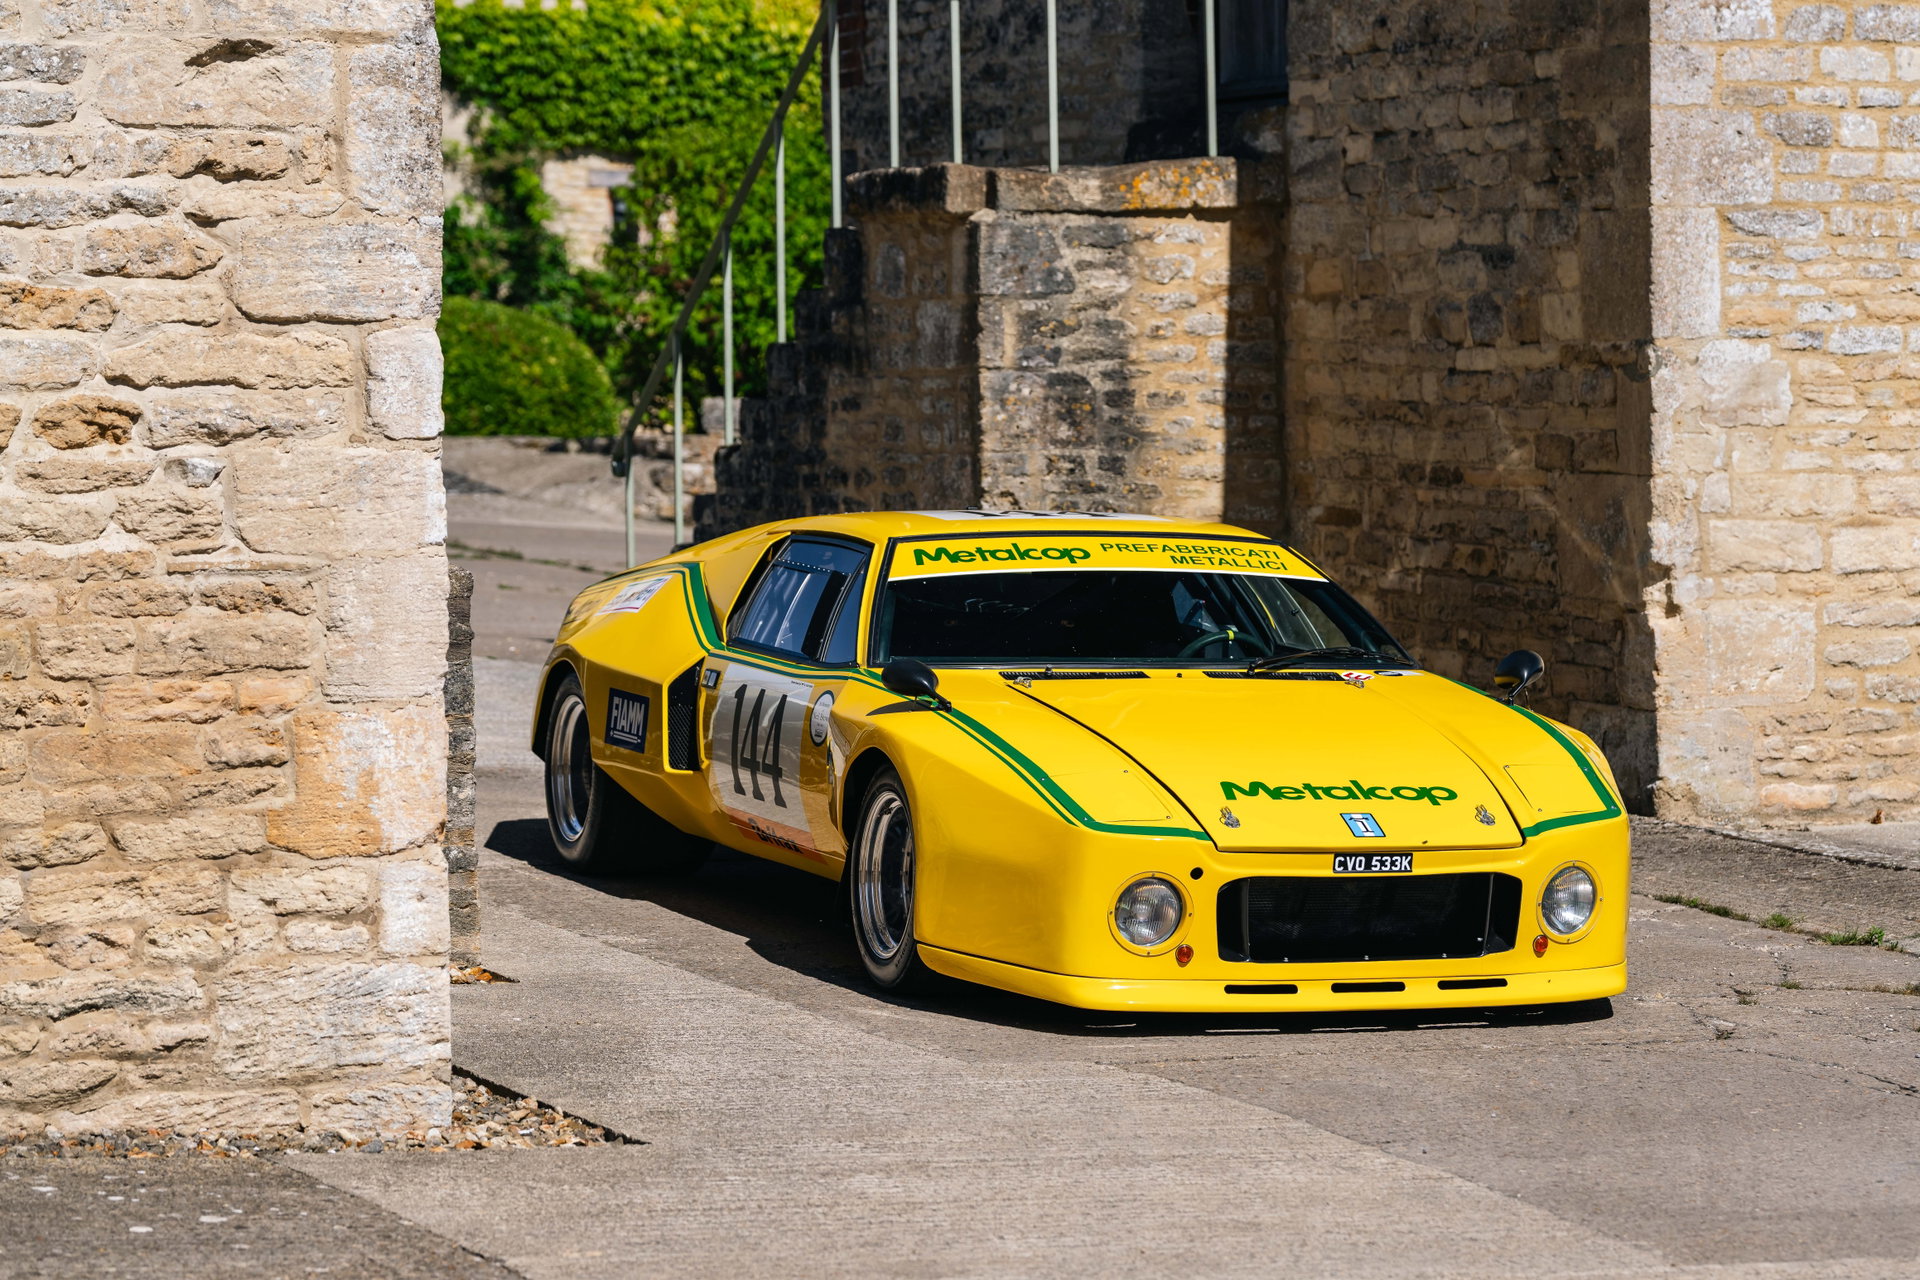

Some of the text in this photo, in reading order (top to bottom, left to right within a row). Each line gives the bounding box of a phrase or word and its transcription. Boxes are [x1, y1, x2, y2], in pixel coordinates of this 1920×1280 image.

[913, 542, 1281, 566] Metalcop PREFABBRICATI
[1169, 555, 1289, 571] METALLICI
[610, 696, 645, 736] FIAMM
[731, 683, 788, 809] 144
[1219, 780, 1459, 806] Metalcop
[1334, 855, 1412, 871] CVO 533K
